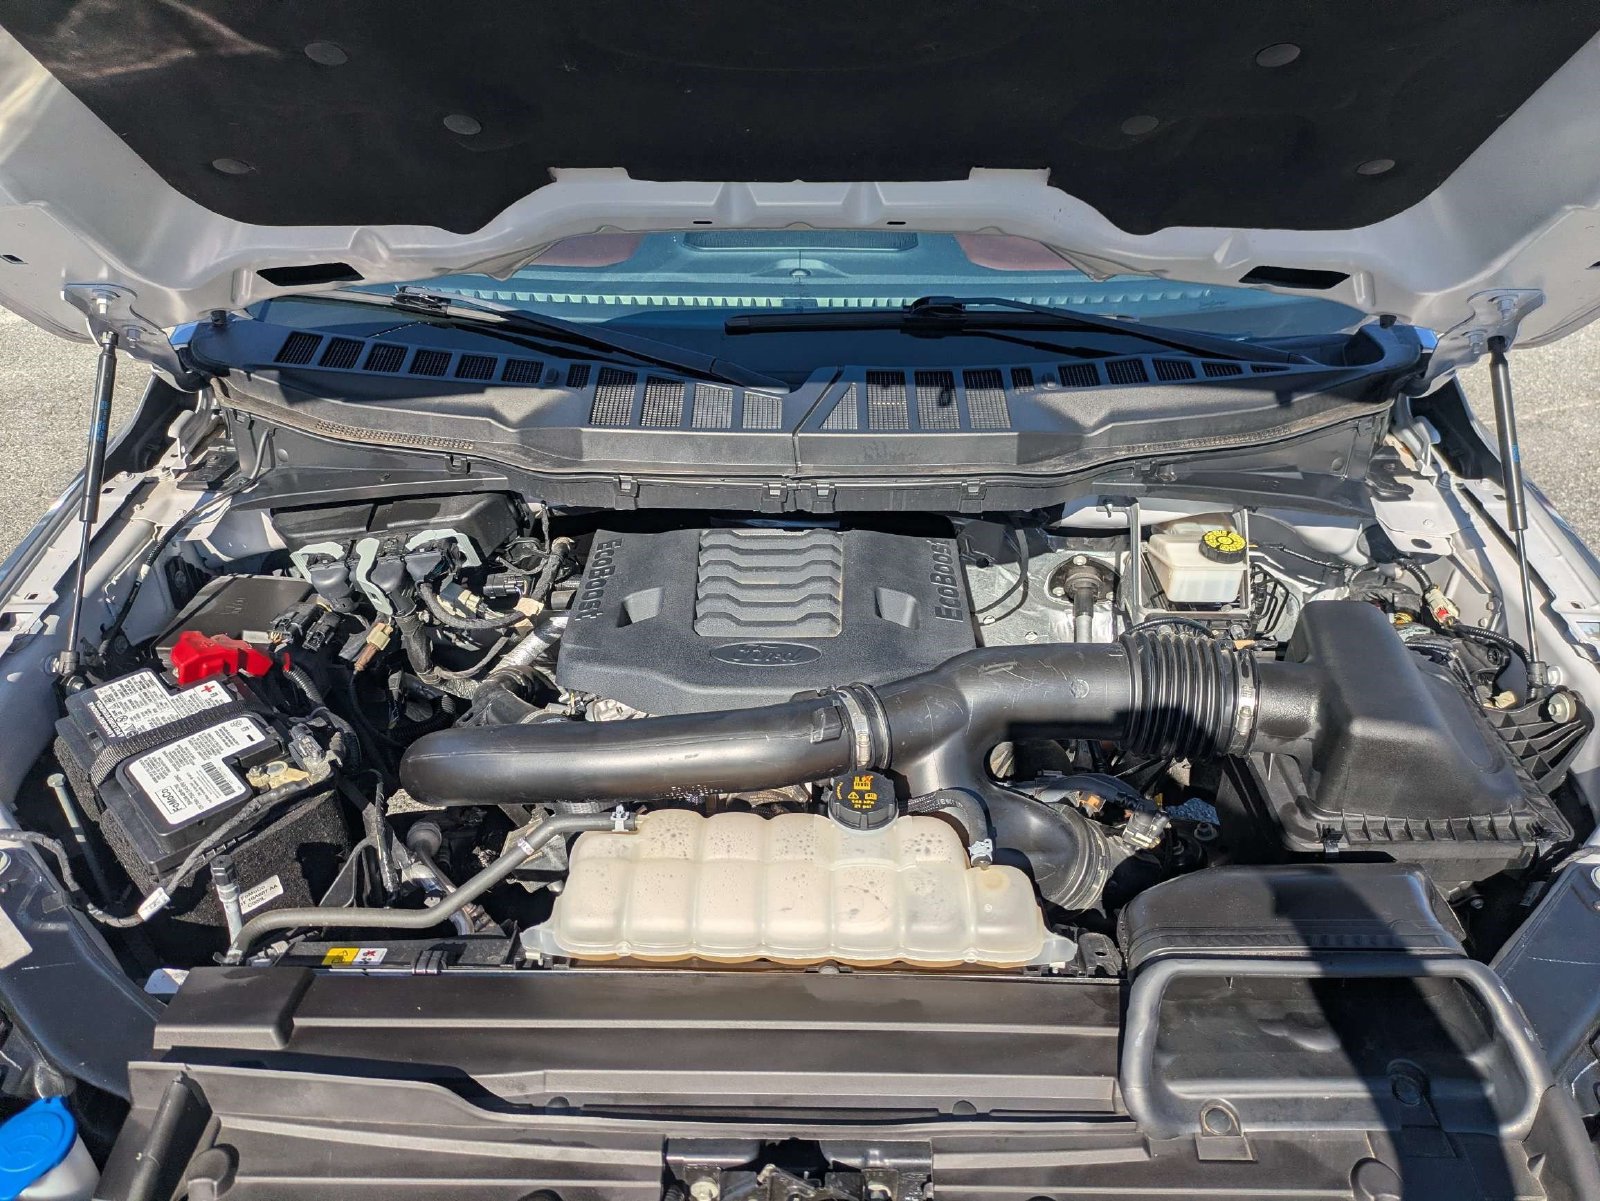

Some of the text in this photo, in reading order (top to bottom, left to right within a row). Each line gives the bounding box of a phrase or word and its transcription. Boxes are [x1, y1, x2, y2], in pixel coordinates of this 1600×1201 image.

[575, 539, 623, 621] EcoBoost
[926, 540, 964, 623] EcoBoost
[161, 788, 182, 812] FoMoCo
